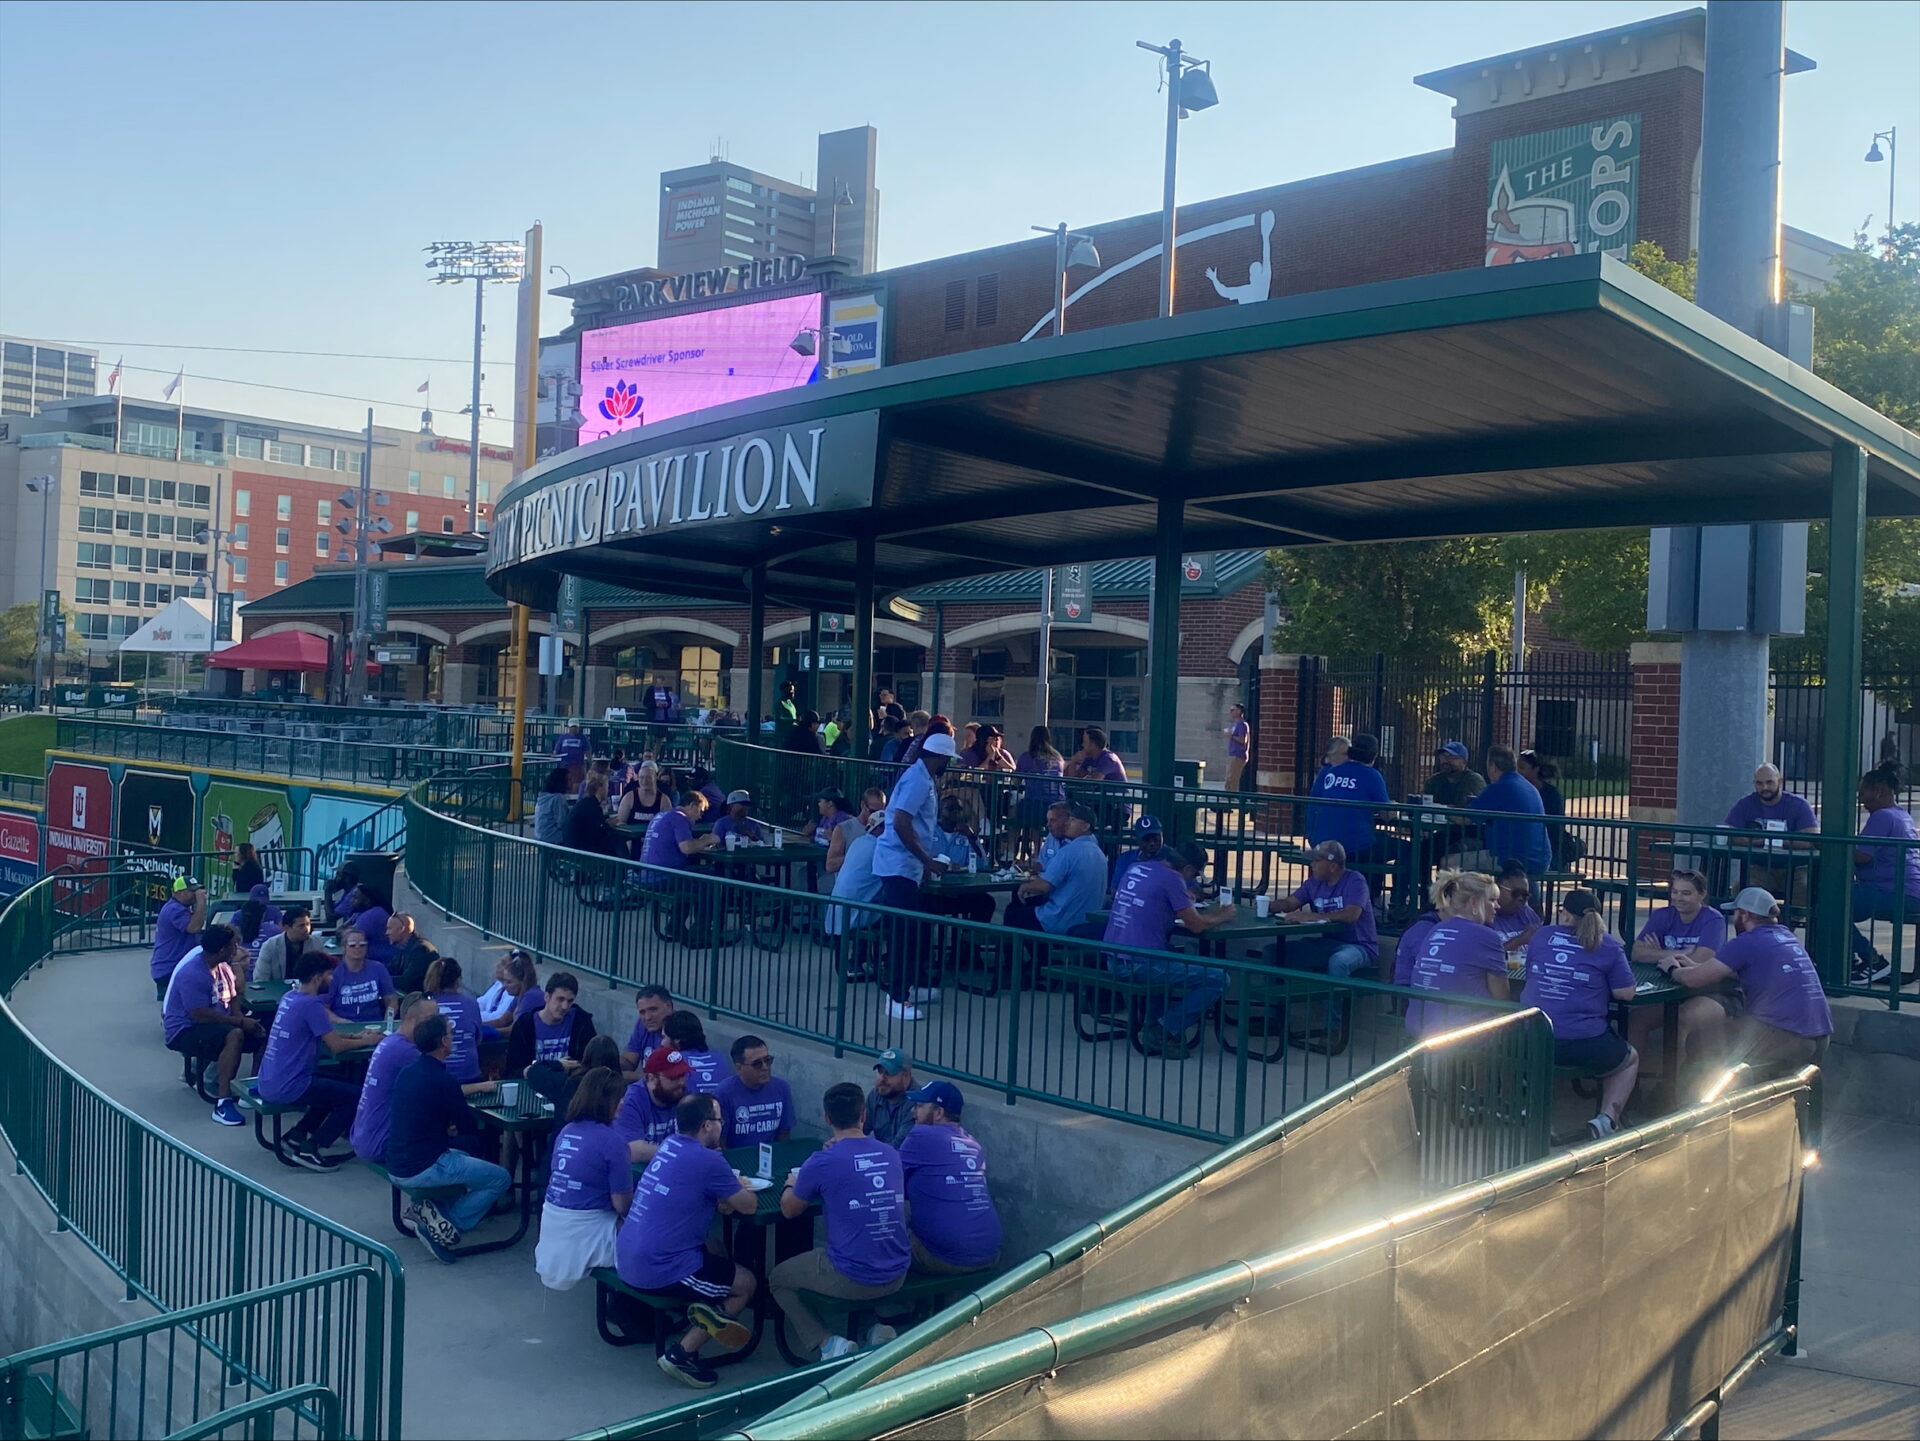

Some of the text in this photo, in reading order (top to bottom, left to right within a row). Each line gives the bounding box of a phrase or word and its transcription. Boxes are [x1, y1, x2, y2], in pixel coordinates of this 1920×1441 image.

[1525, 156, 1573, 192] THE
[676, 205, 721, 221] MICHIGAN
[677, 196, 716, 210] INDIANA
[675, 218, 706, 232] POWER
[737, 253, 807, 291] FIELD
[848, 332, 864, 342] OLD
[591, 348, 706, 373] Silver Screwdriver Sponsor
[521, 477, 600, 558] PICNIC
[605, 427, 827, 536] PAVILION
[1334, 776, 1357, 789] PBS
[1, 828, 30, 853] Gazette
[49, 830, 107, 857] INDIANA UNIVERSITY
[735, 1123, 750, 1135] DAY
